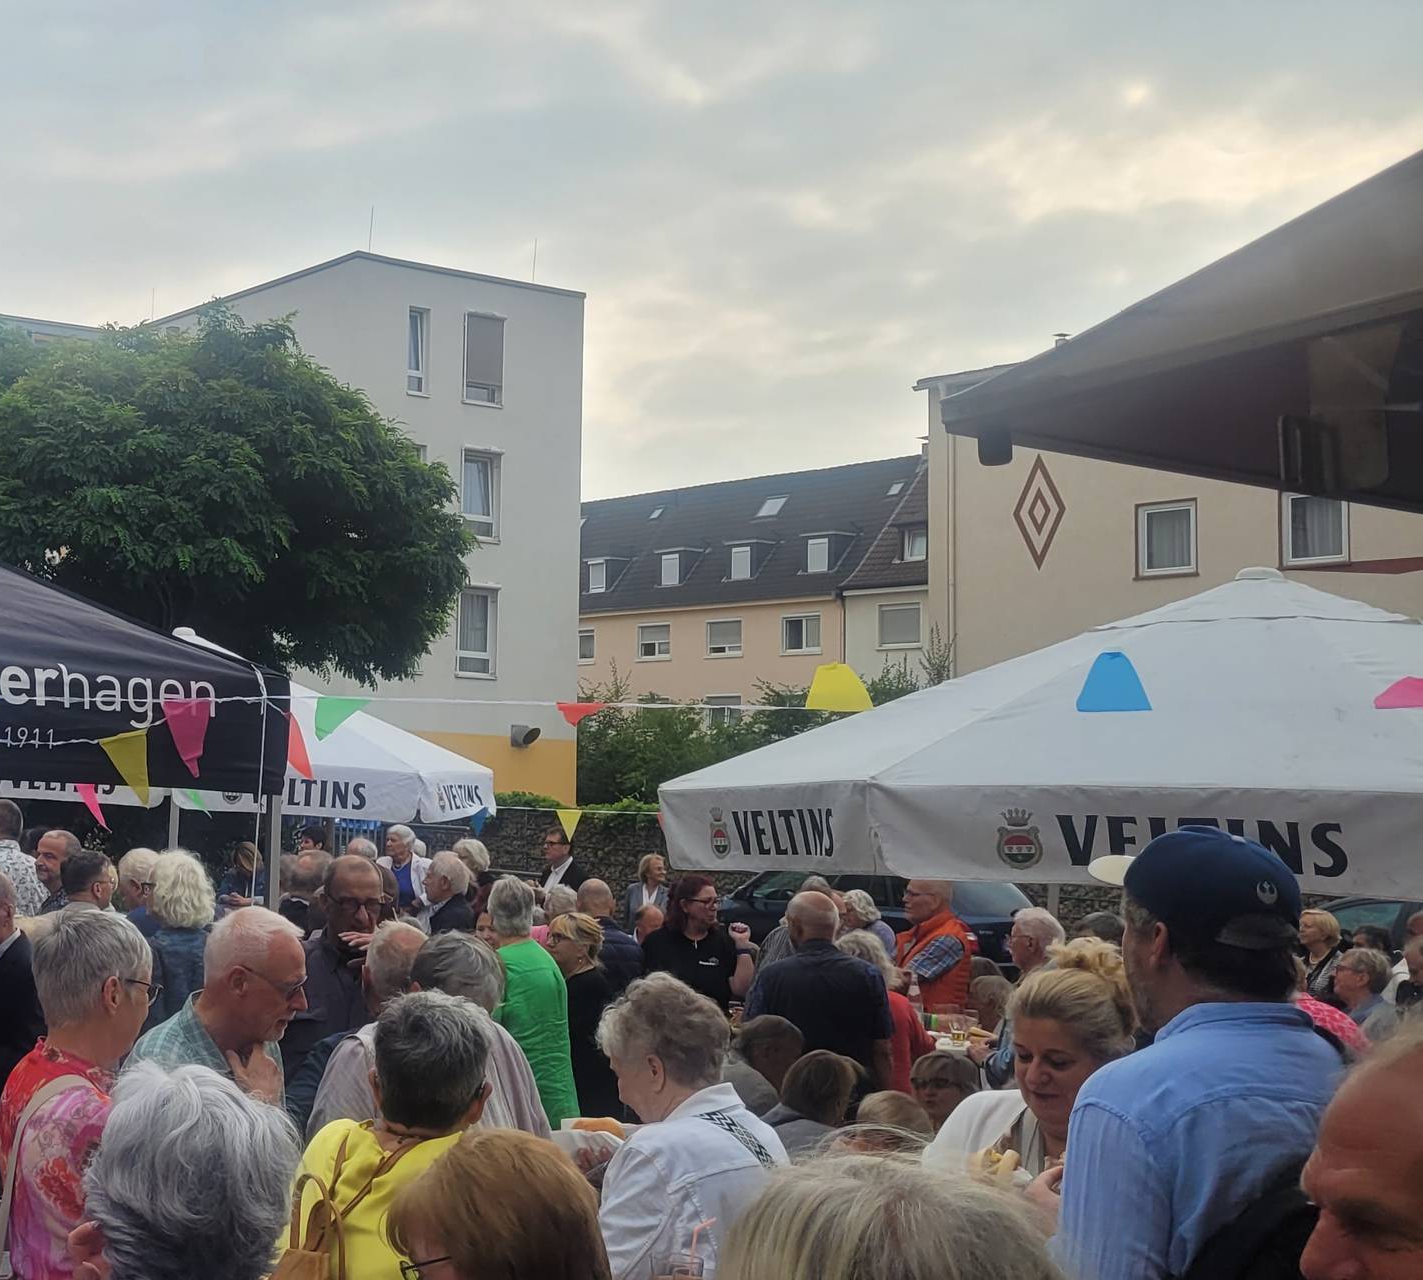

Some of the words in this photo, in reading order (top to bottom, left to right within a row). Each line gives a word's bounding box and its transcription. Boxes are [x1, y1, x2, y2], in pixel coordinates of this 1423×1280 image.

[4, 726, 55, 750] 1911
[287, 777, 367, 811] LTINS
[731, 807, 835, 858] VELTINS
